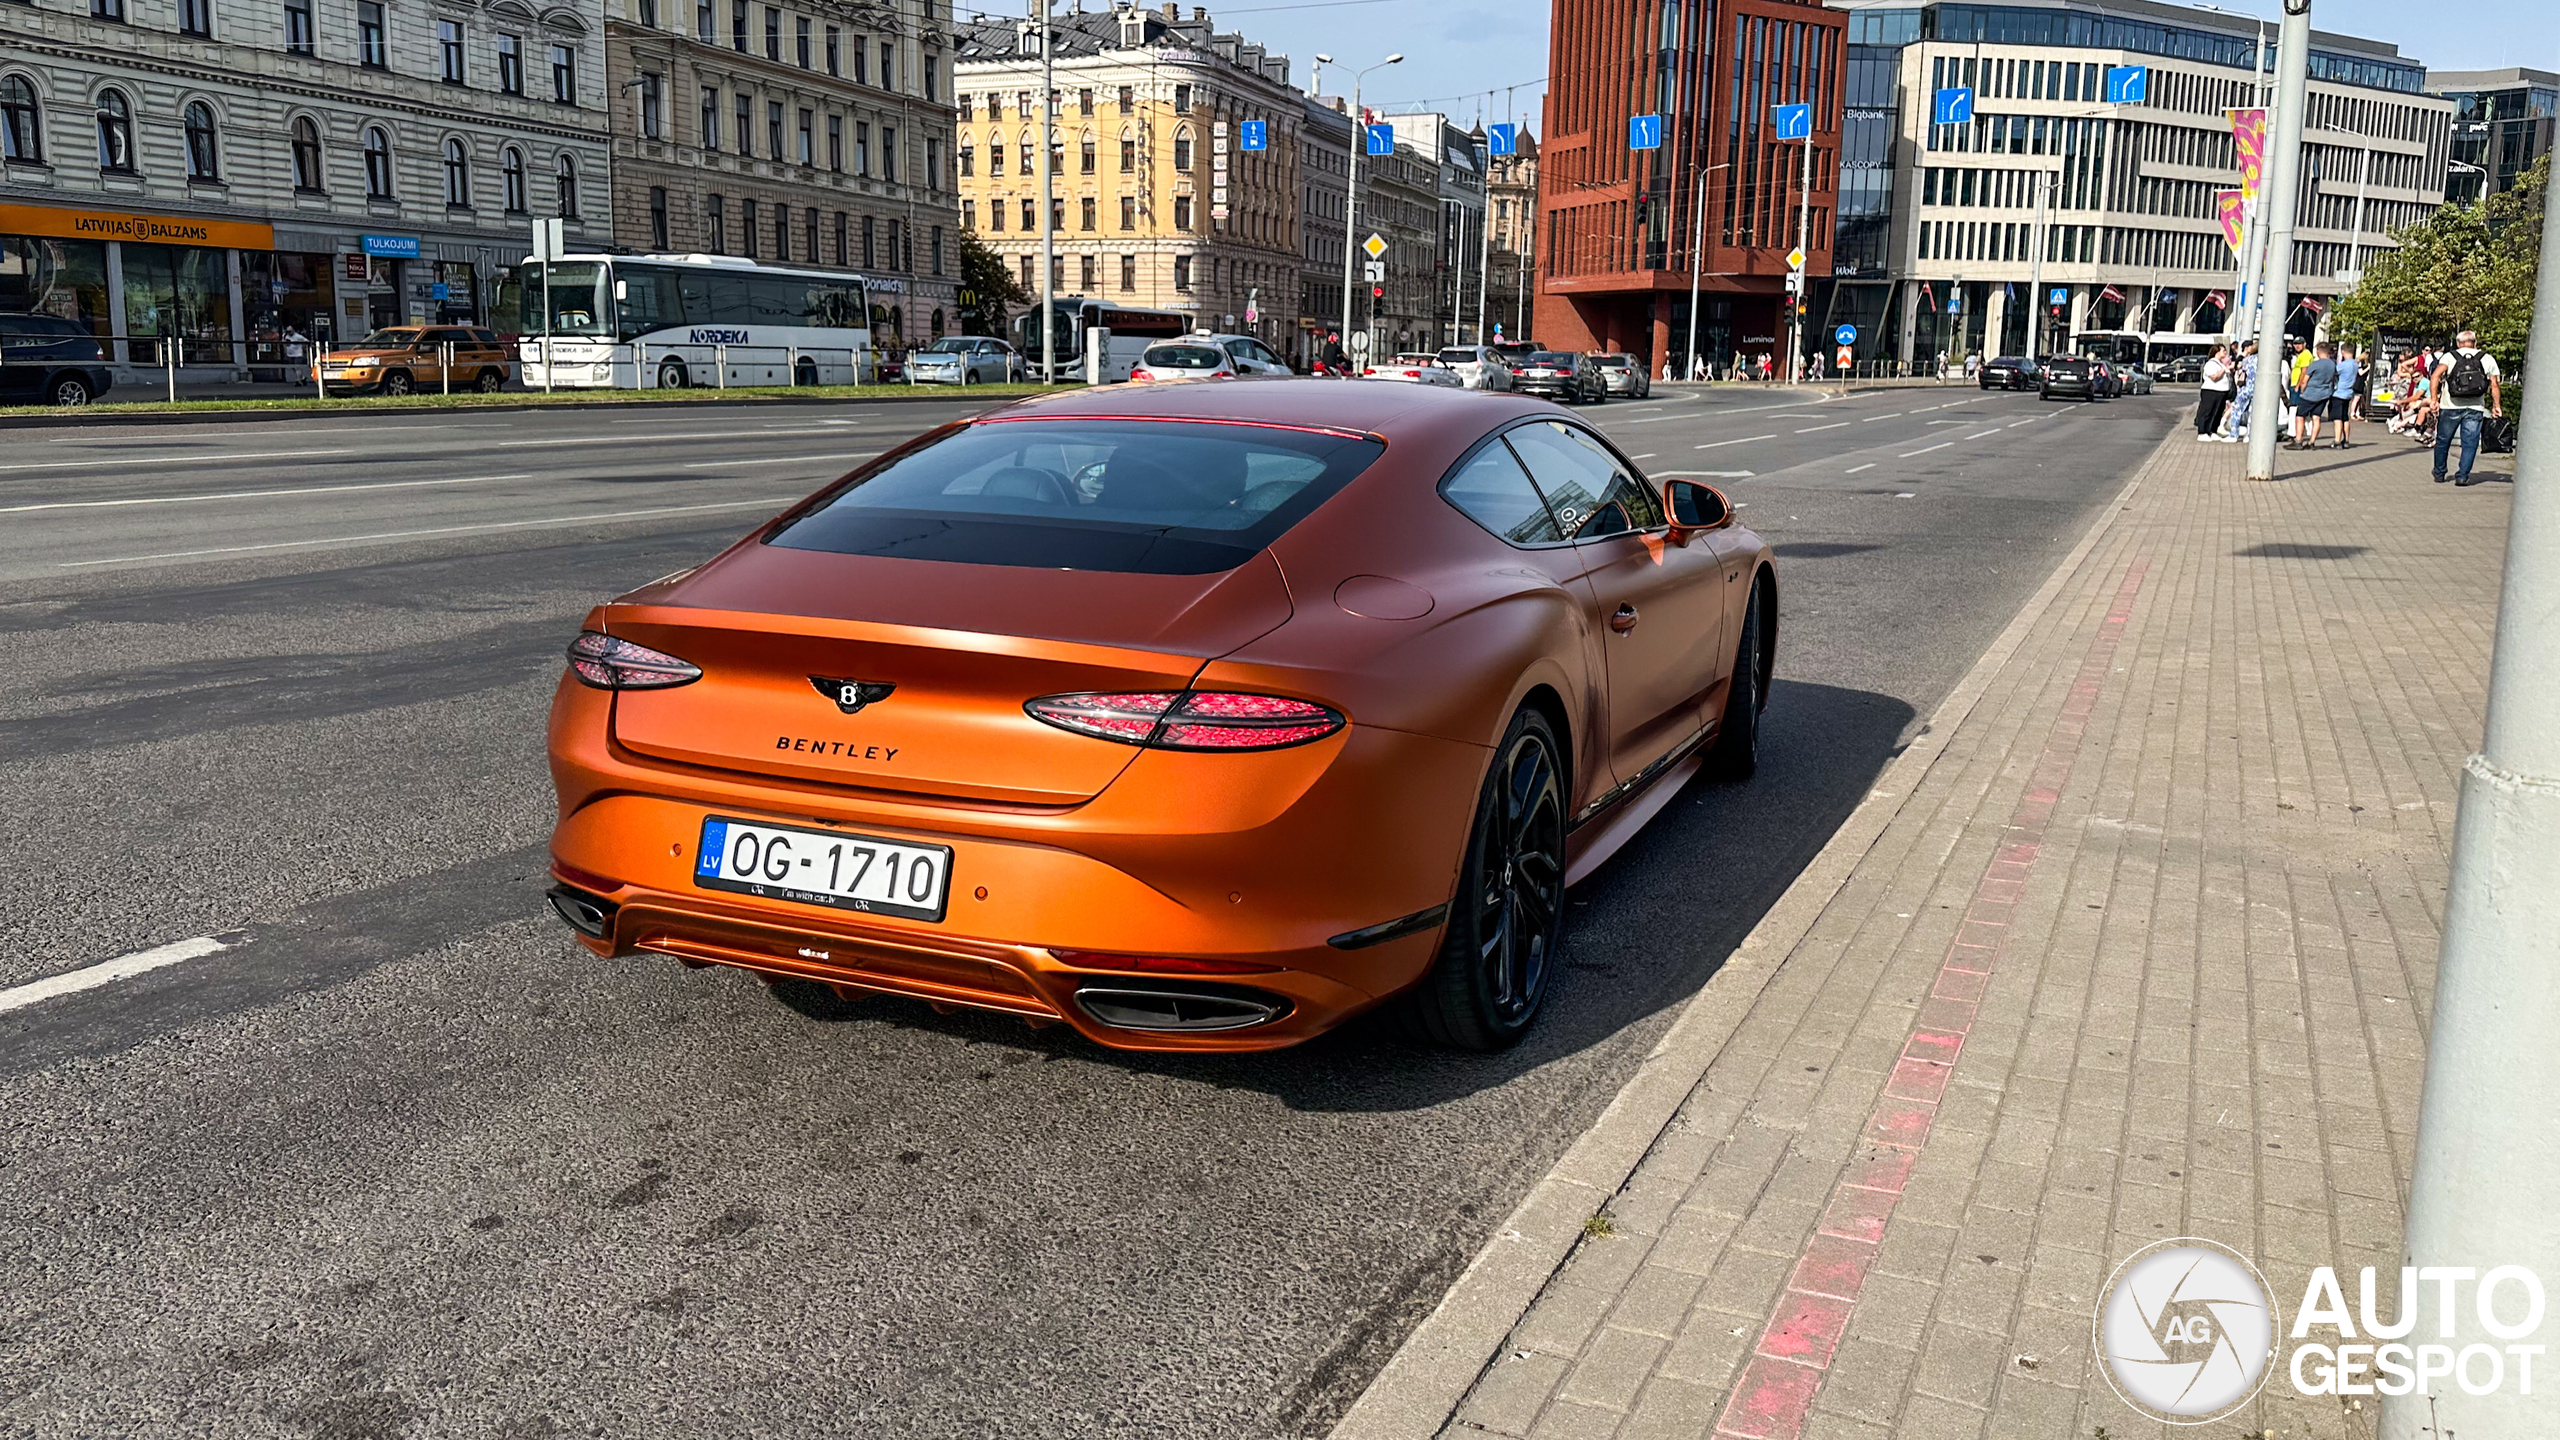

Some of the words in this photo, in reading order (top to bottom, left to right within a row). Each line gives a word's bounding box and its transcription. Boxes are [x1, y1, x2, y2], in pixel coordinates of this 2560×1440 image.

[1847, 109, 1885, 122] Bigbank
[75, 218, 132, 235] LATVIJAS
[151, 224, 207, 240] BALZAMS
[367, 238, 417, 250] TULKOJUMI
[1835, 266, 1858, 276] Wolt
[689, 329, 749, 344] NORDEKA
[1743, 334, 1775, 343] Luminor
[840, 685, 857, 705] B
[776, 737, 899, 761] BENTLEY
[703, 854, 720, 870] LV
[732, 832, 934, 902] OG-1710
[781, 888, 794, 898] I'm
[796, 892, 813, 901] with
